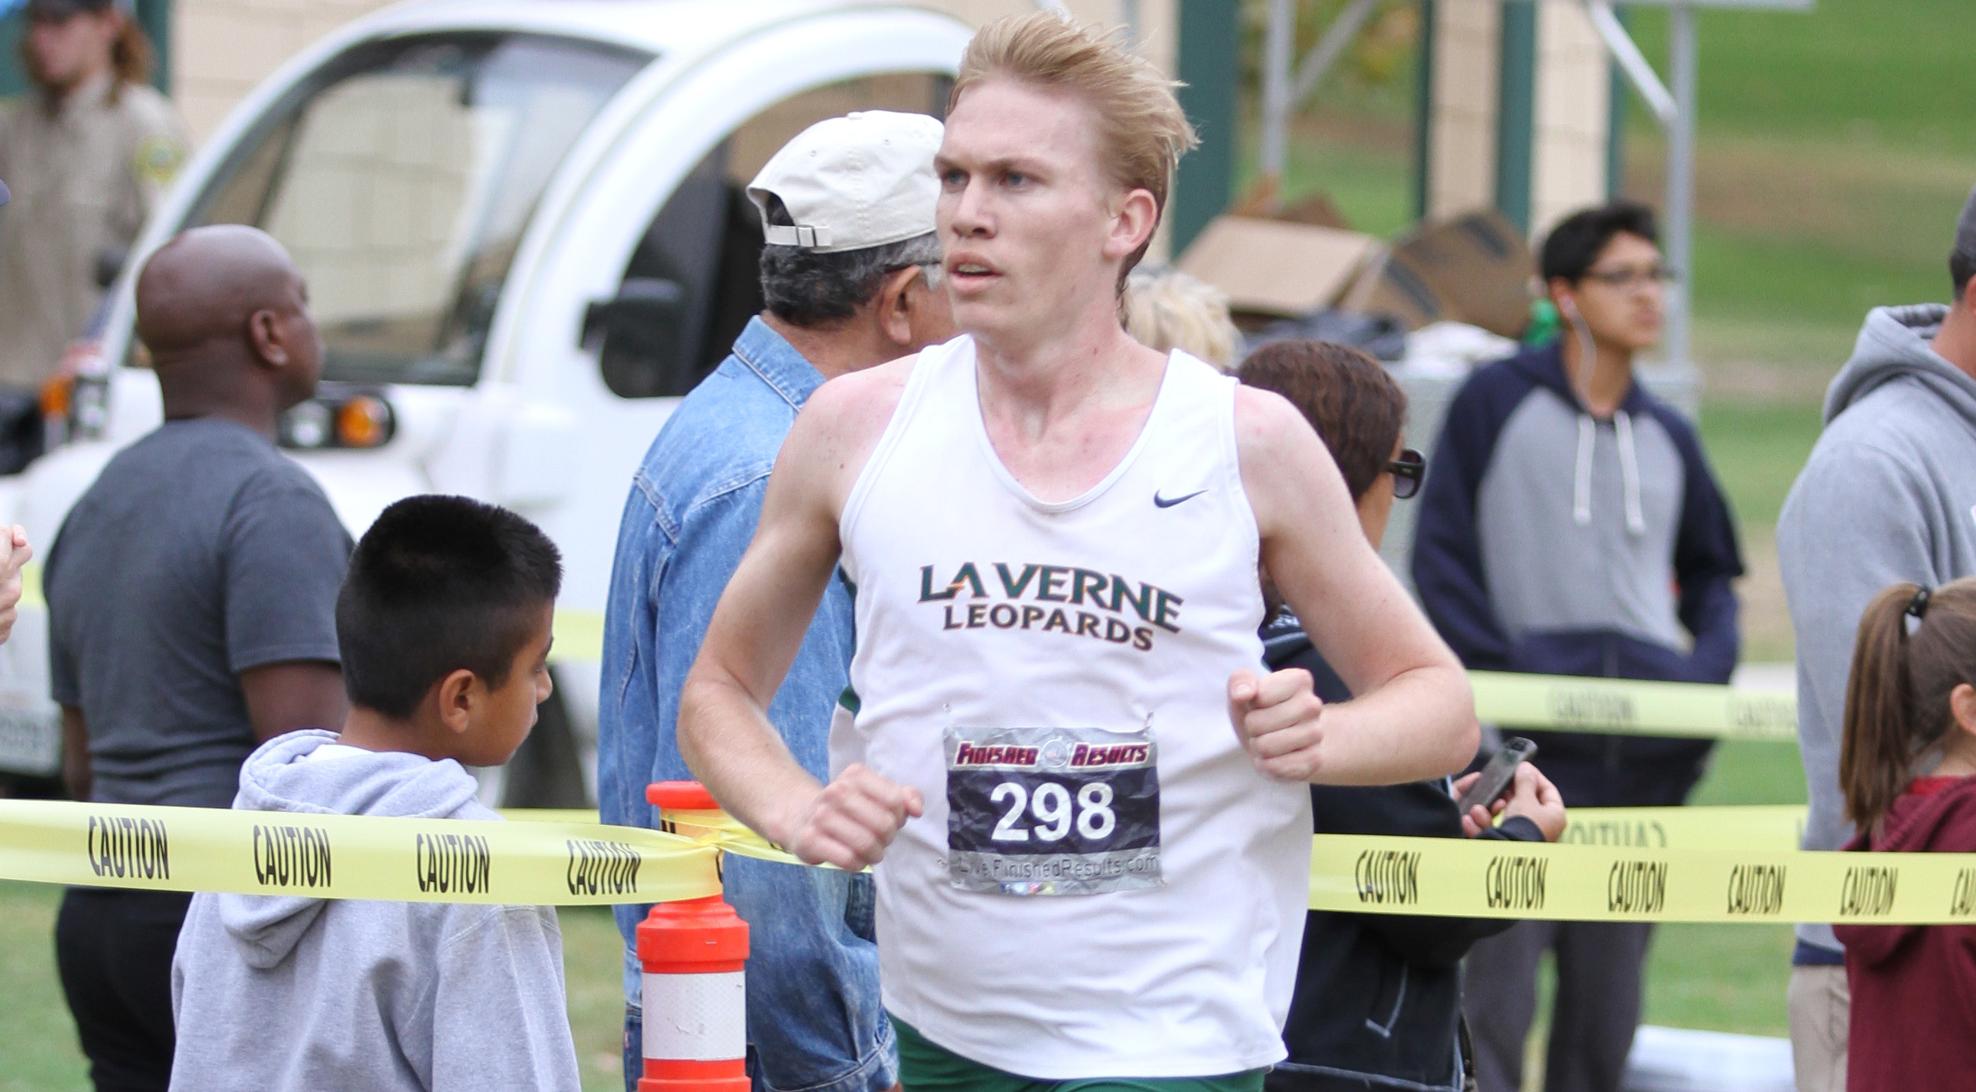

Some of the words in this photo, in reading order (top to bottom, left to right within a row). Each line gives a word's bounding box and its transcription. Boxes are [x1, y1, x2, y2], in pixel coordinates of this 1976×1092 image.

[918, 562, 989, 603] LA
[992, 562, 1184, 634] VERNE
[943, 603, 1154, 651] LEOPARDS
[1069, 742, 1149, 766] RESULTS
[990, 782, 1116, 842] 298
[88, 815, 169, 880] CAUTION
[253, 825, 331, 888] CAUTION
[416, 833, 490, 894] CAUTION
[566, 839, 641, 895] CAUTION
[1355, 850, 1421, 905] CAUTION
[1486, 856, 1548, 910] CAUTION
[1608, 861, 1668, 913] CAUTION
[1728, 864, 1787, 914] CAUTION
[1840, 867, 1898, 916] CAUTION
